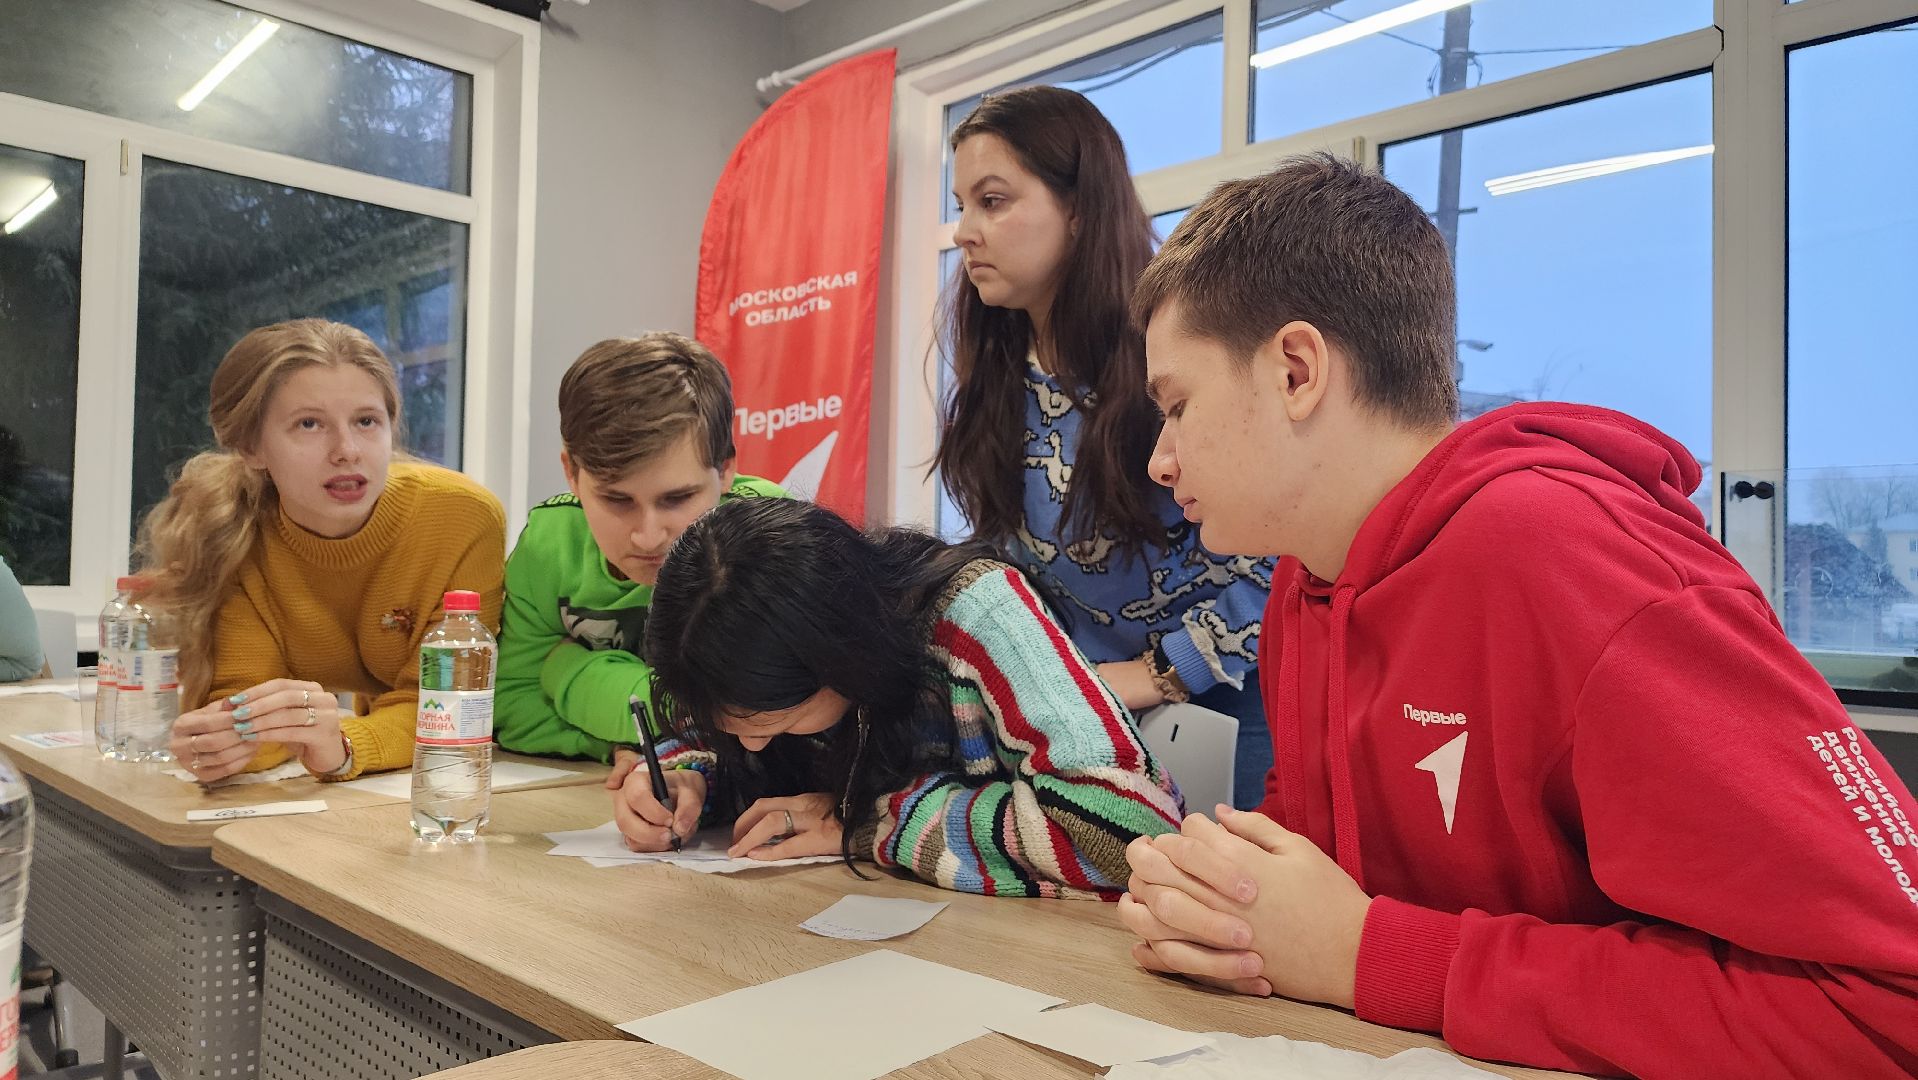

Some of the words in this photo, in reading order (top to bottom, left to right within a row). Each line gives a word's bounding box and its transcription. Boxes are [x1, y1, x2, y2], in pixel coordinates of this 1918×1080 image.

[744, 296, 832, 327] ОБЛАСТЬ
[416, 720, 456, 731] ЕРШИНА
[1403, 703, 1467, 727] Первые
[1806, 735, 1861, 802] детей
[1852, 805, 1872, 822] и
[1865, 826, 1918, 907] молод
[1822, 730, 1907, 847] движение
[1841, 726, 1918, 858] Российско
